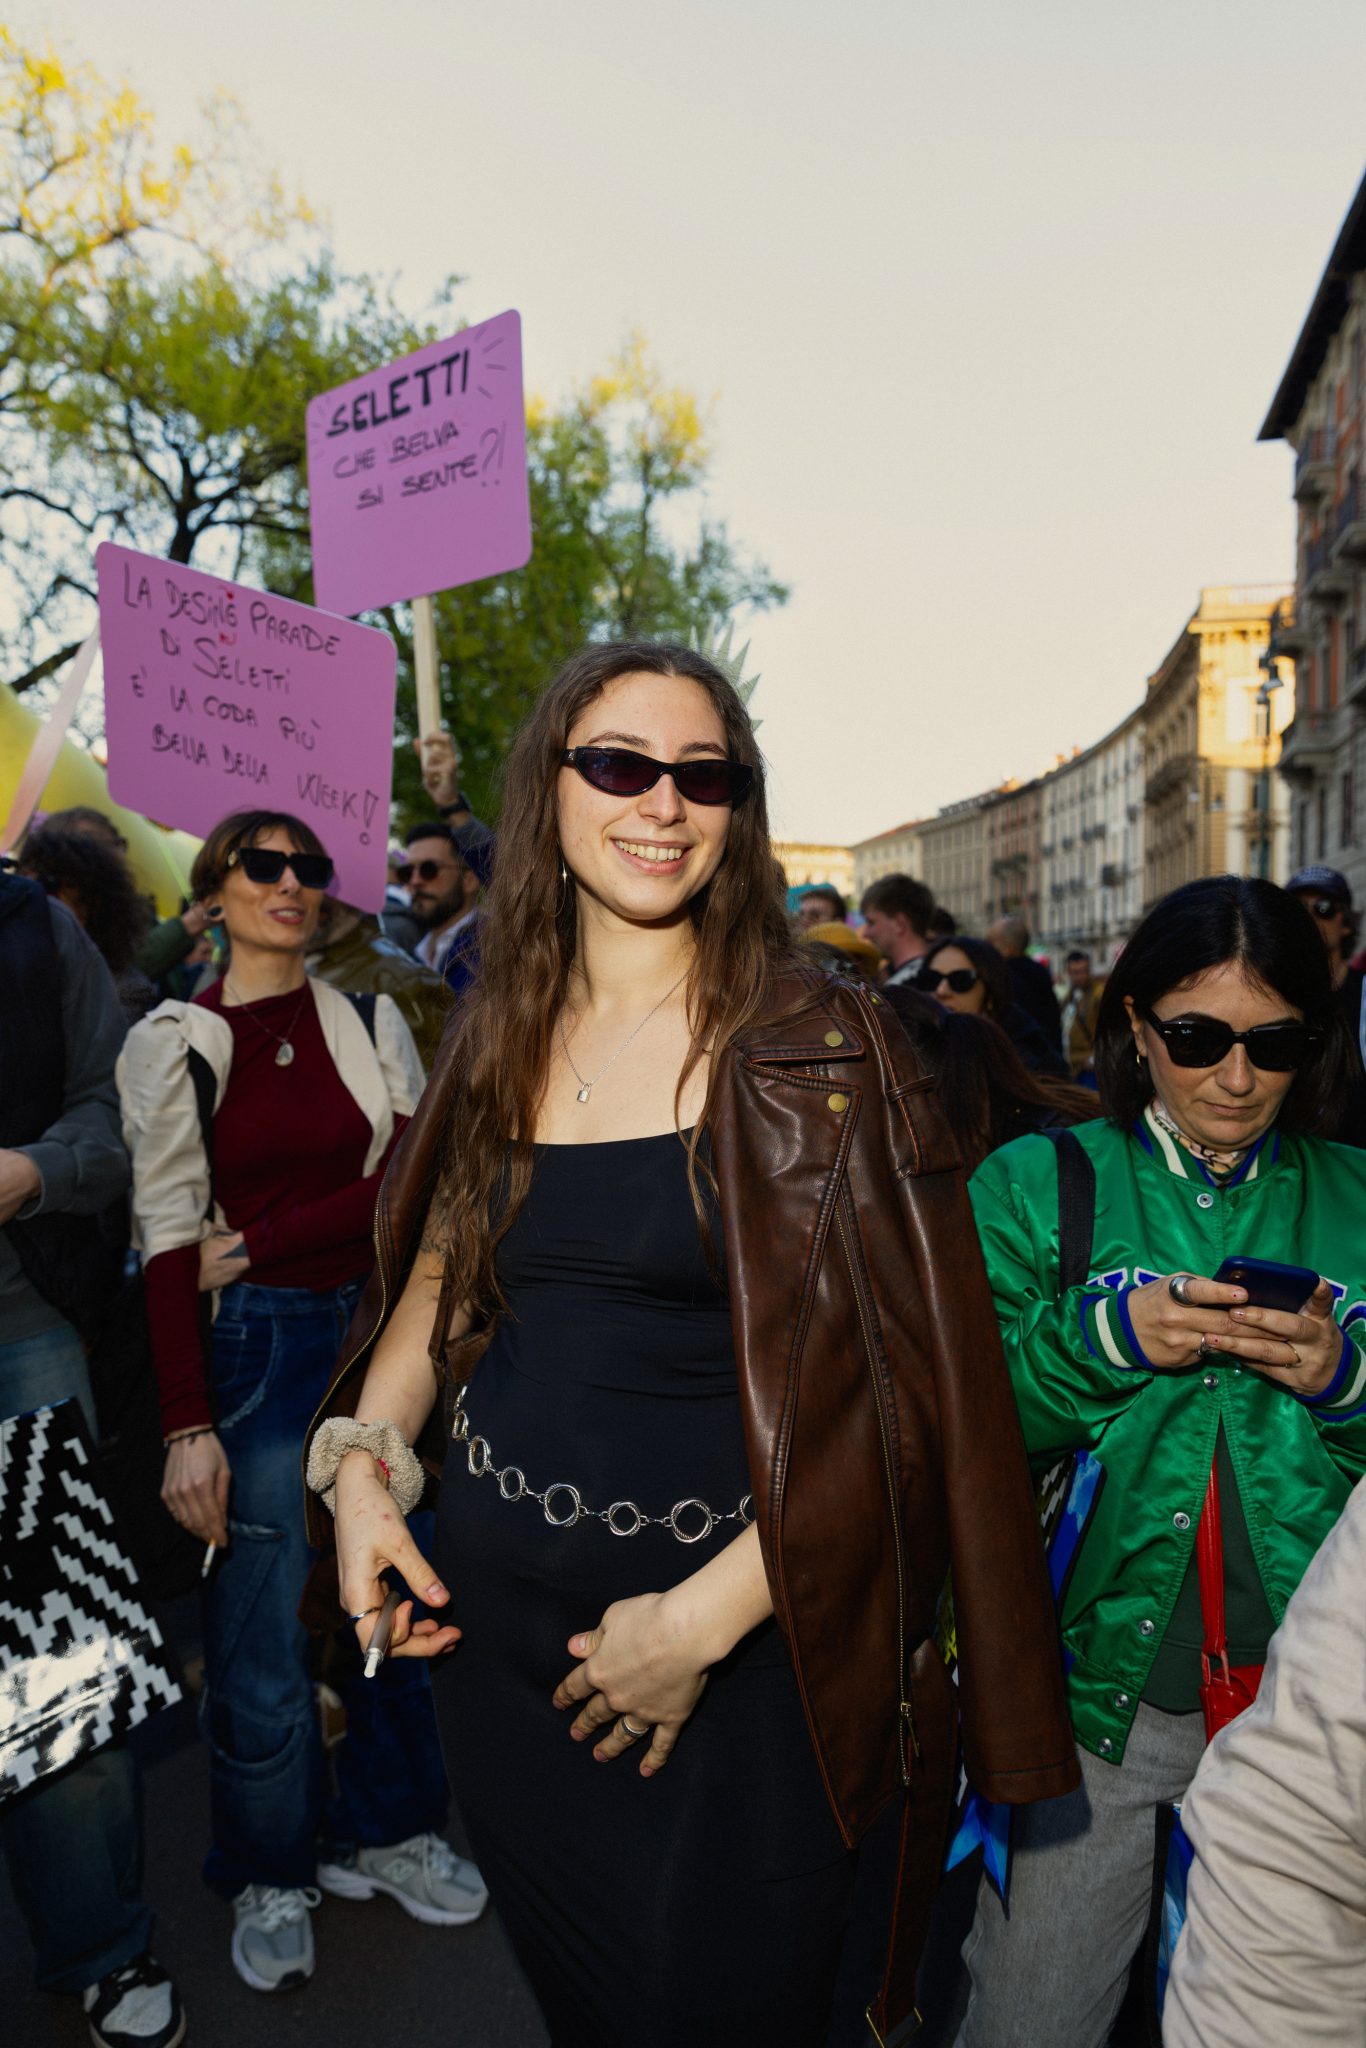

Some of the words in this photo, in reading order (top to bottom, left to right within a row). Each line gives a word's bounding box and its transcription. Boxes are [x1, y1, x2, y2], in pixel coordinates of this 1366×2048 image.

[326, 347, 470, 438] SELETTI
[333, 447, 376, 479] CHE
[388, 419, 459, 463] BELVA
[356, 484, 384, 510] SI
[124, 562, 151, 609] LA
[250, 600, 340, 656] PARADE
[170, 685, 193, 714] LA
[203, 695, 258, 727] CODA
[152, 724, 210, 767] BELLA
[223, 745, 269, 784] DELLA
